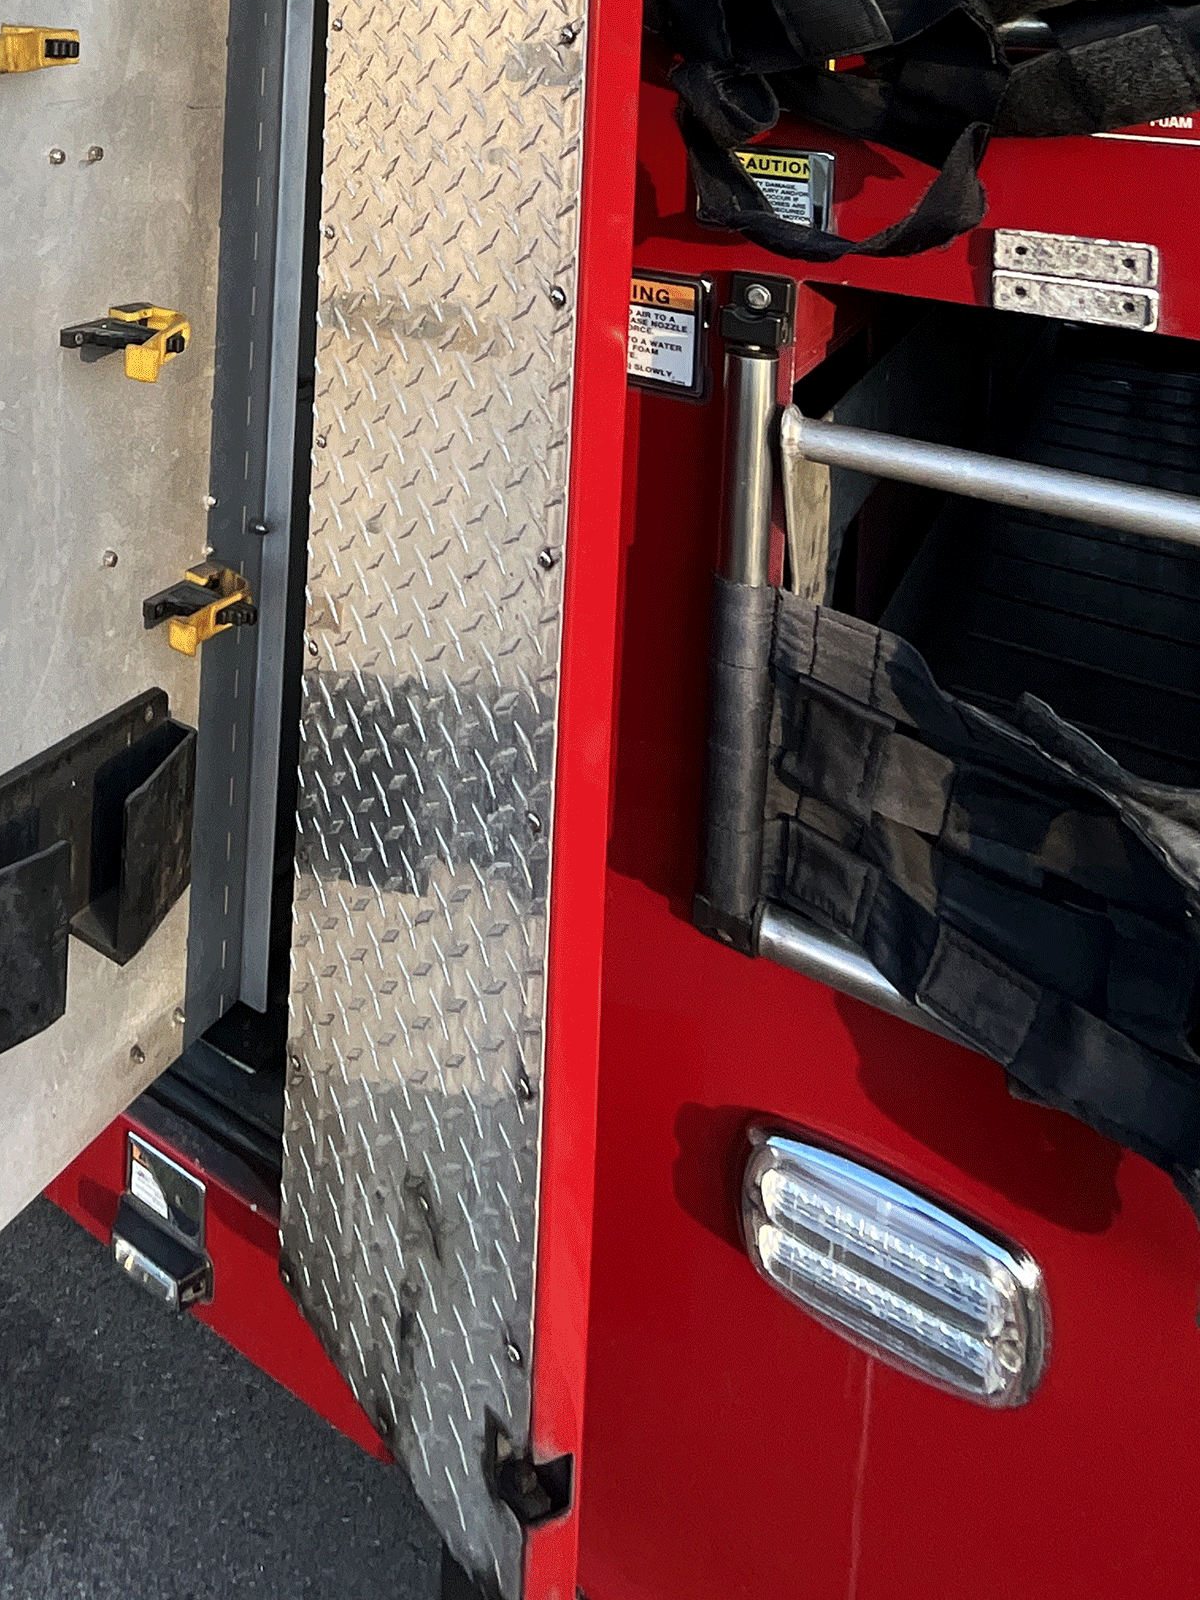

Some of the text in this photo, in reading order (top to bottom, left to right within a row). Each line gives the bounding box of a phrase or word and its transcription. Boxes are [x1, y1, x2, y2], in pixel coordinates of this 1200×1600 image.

[636, 310, 651, 319] AIR
[654, 313, 667, 321] TO
[651, 320, 688, 333] NOZZLE
[632, 344, 659, 356] FOAM
[649, 340, 682, 353] WATER
